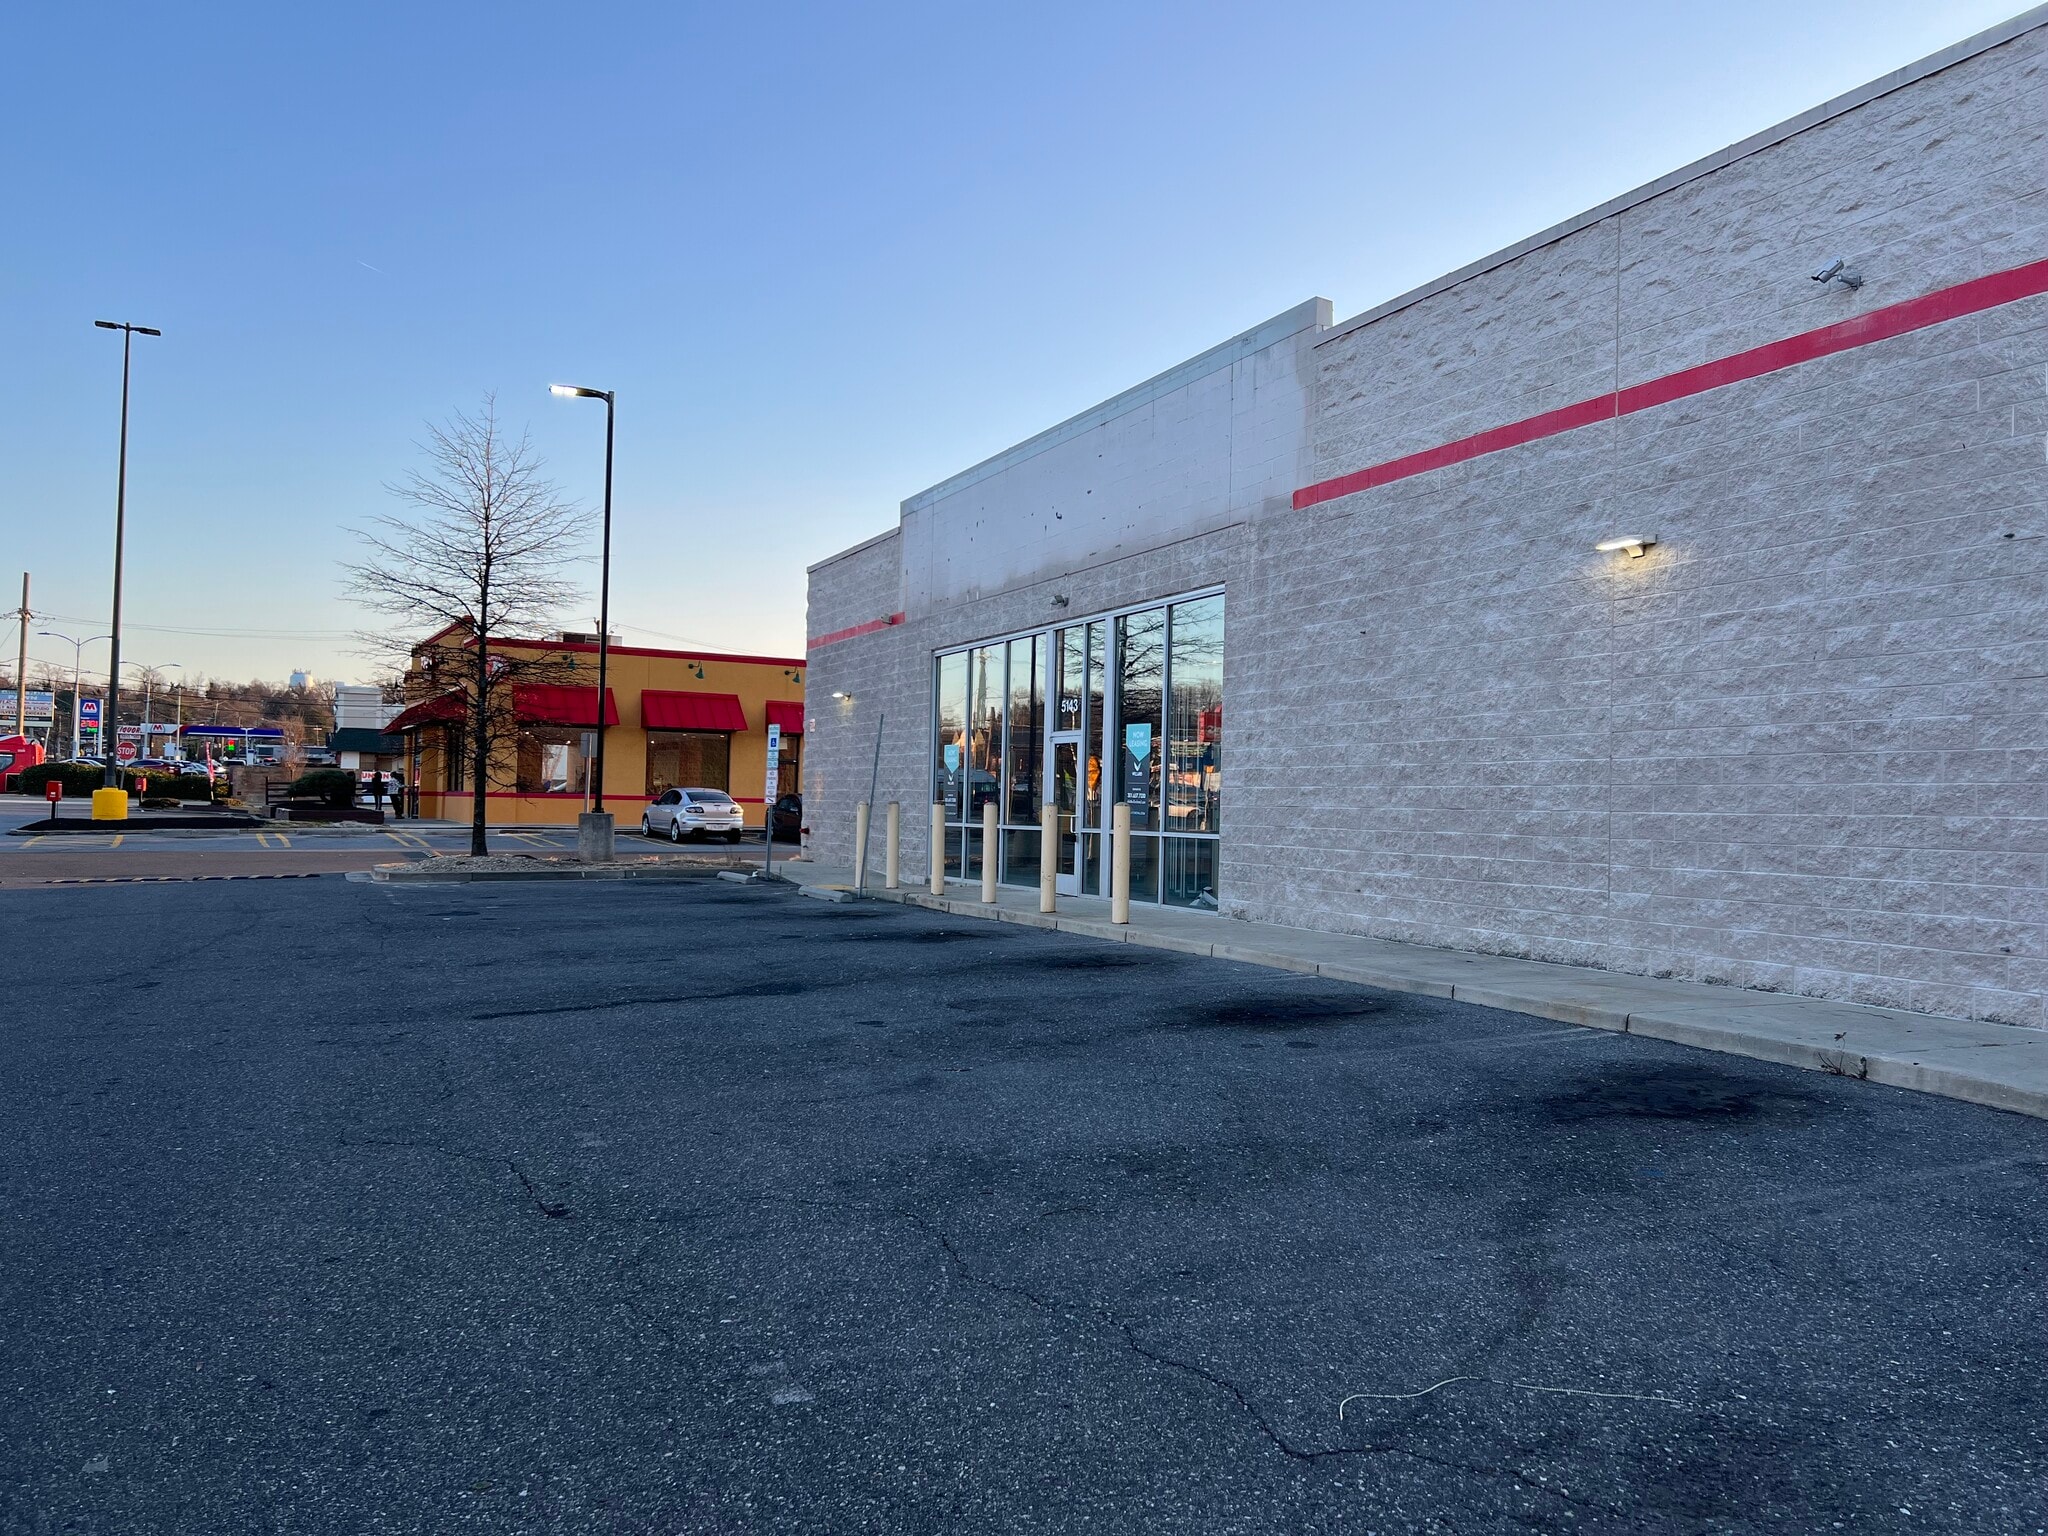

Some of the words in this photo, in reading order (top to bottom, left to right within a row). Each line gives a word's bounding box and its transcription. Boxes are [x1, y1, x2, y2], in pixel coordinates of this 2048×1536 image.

[1061, 699, 1078, 713] 5143
[1132, 731, 1145, 739] NOW
[117, 747, 135, 755] STOP
